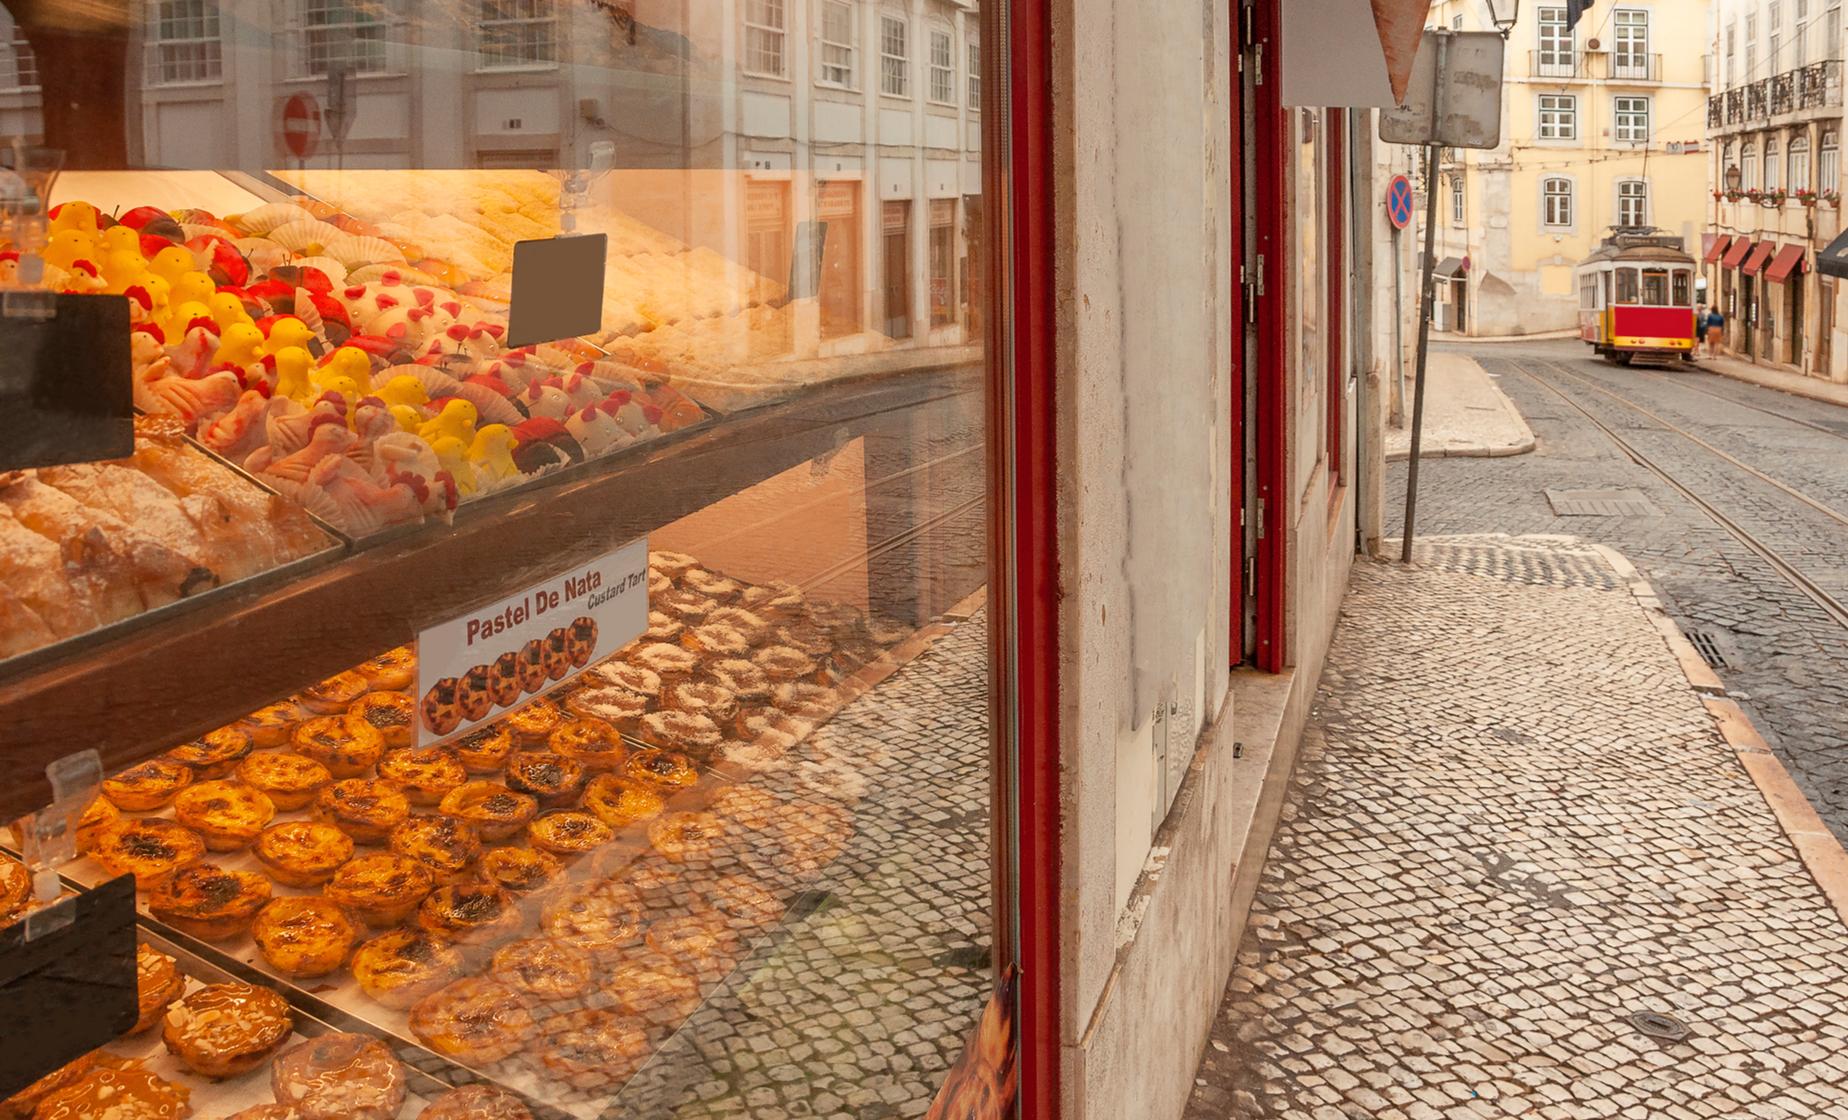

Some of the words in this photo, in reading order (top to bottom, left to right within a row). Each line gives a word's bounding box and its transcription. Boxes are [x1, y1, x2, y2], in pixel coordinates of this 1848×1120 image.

[467, 598, 530, 645] Pastel
[536, 590, 559, 615] De
[565, 570, 601, 602] Nata
[587, 577, 625, 610] Custard
[627, 568, 646, 590] Tart
